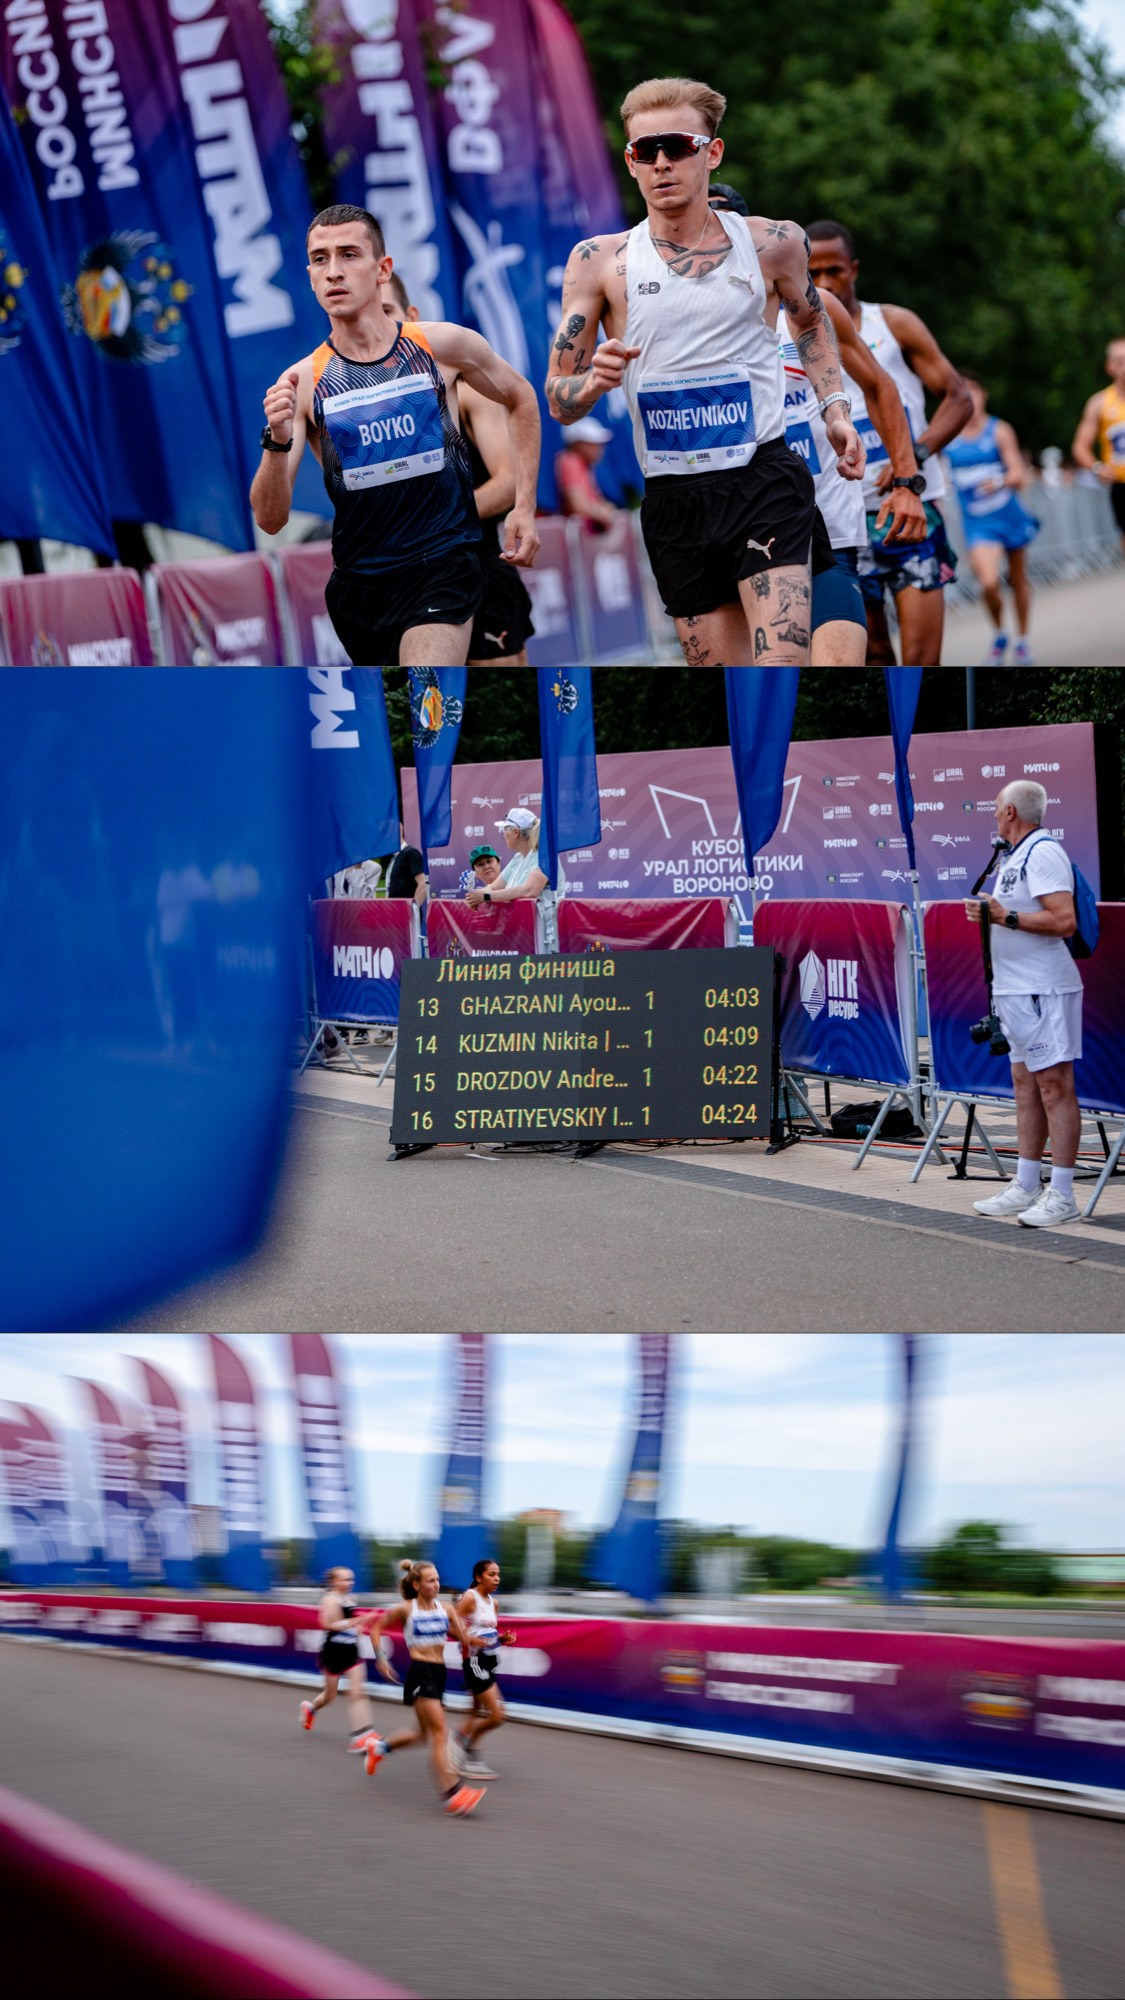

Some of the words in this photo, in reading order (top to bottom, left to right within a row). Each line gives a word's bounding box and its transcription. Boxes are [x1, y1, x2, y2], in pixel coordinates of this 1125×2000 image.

[646, 401, 748, 430] KOZHEVNIKOV
[358, 413, 416, 447] BOYKO
[946, 768, 963, 776] URAL
[835, 806, 851, 814] URAL
[643, 859, 689, 876] УРАЛ
[950, 867, 967, 875] URAL
[673, 875, 774, 893] ВОРОНОВО
[436, 959, 511, 982] Линия
[519, 956, 615, 985] финиша
[827, 959, 859, 999] НГК
[417, 998, 439, 1017] 13
[461, 994, 563, 1016] GHAZRANI
[645, 991, 654, 1010] 1
[705, 987, 760, 1008] 04:03
[828, 1000, 859, 1020] ресурс
[415, 1035, 438, 1054] 14
[459, 1032, 536, 1053] KUZMIN
[542, 1031, 598, 1051] Nikita
[644, 1029, 653, 1048] 1
[704, 1025, 759, 1047] 04:09
[413, 1073, 436, 1092] 15
[456, 1070, 552, 1092] DROZDOV
[643, 1067, 652, 1087] 1
[703, 1064, 758, 1086] 04:22
[411, 1111, 433, 1130] 16
[454, 1106, 607, 1130] STRATIYEVSKIY
[642, 1106, 650, 1126] 1
[702, 1103, 758, 1125] 04:24
